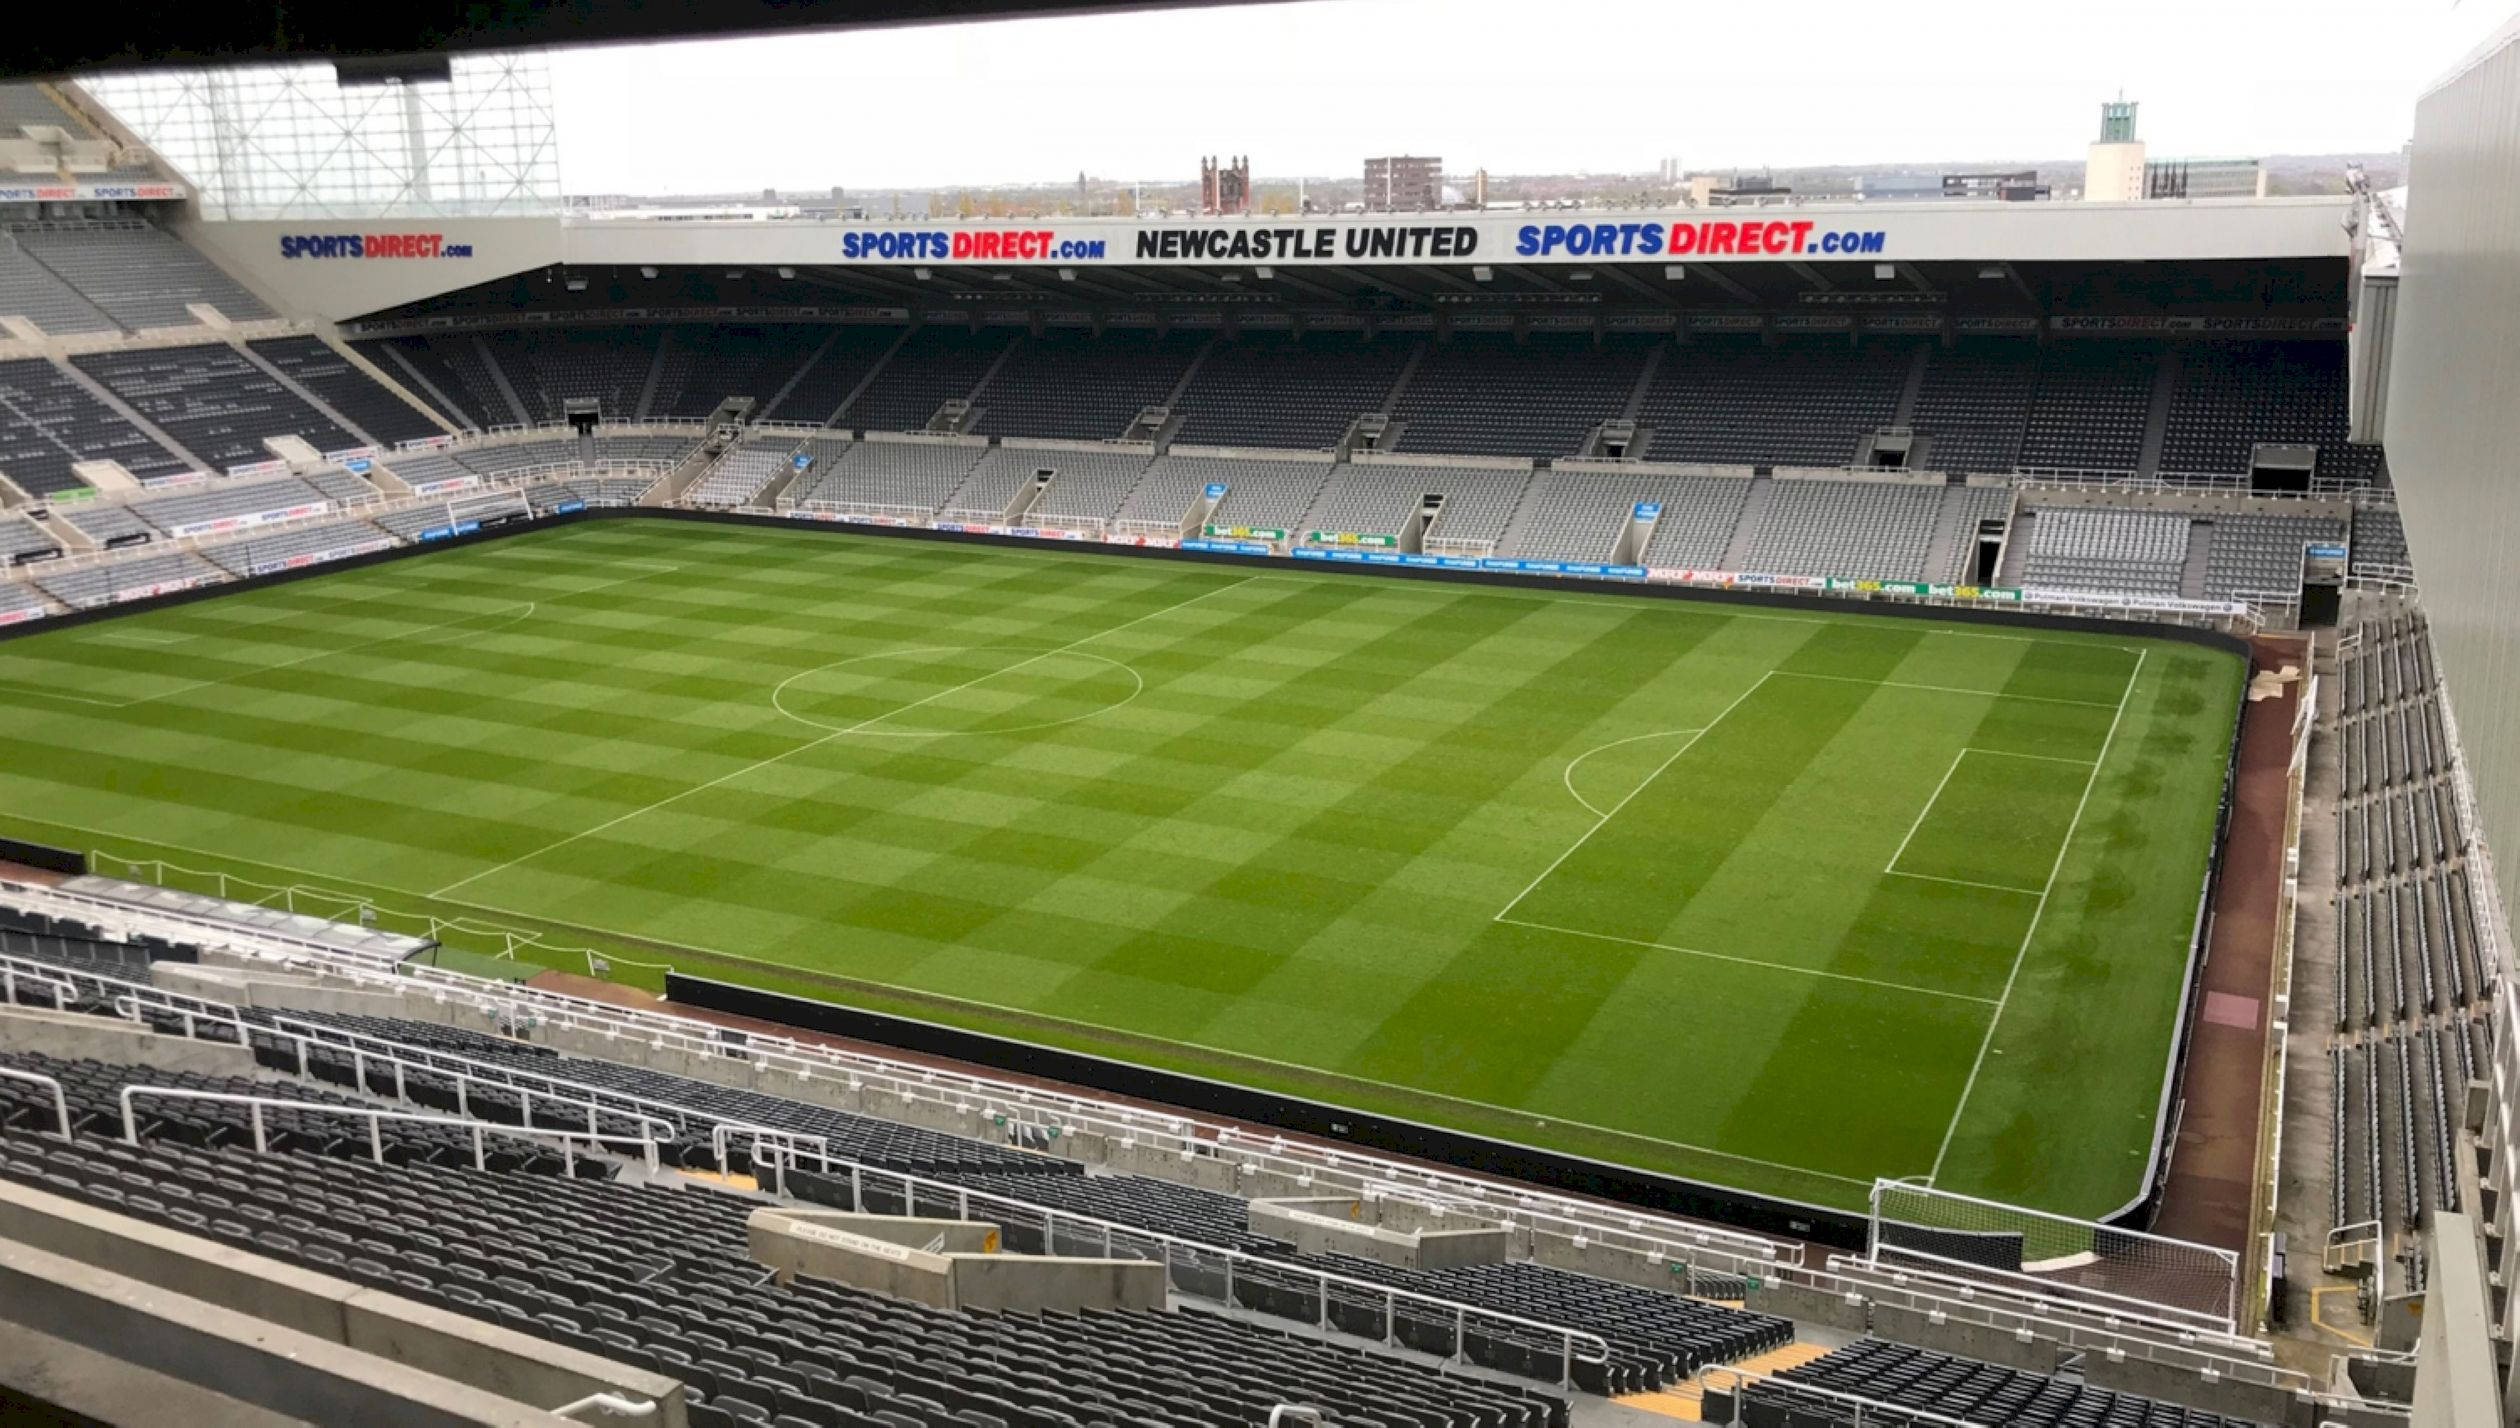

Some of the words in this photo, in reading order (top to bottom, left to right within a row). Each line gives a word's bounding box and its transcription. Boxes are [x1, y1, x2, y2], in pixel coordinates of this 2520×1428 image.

[1136, 228, 1337, 259] NEWCASTLE
[1346, 227, 1478, 258] UNITED
[1832, 578, 1915, 593] bet365.com
[1928, 583, 2016, 599] bet365.com
